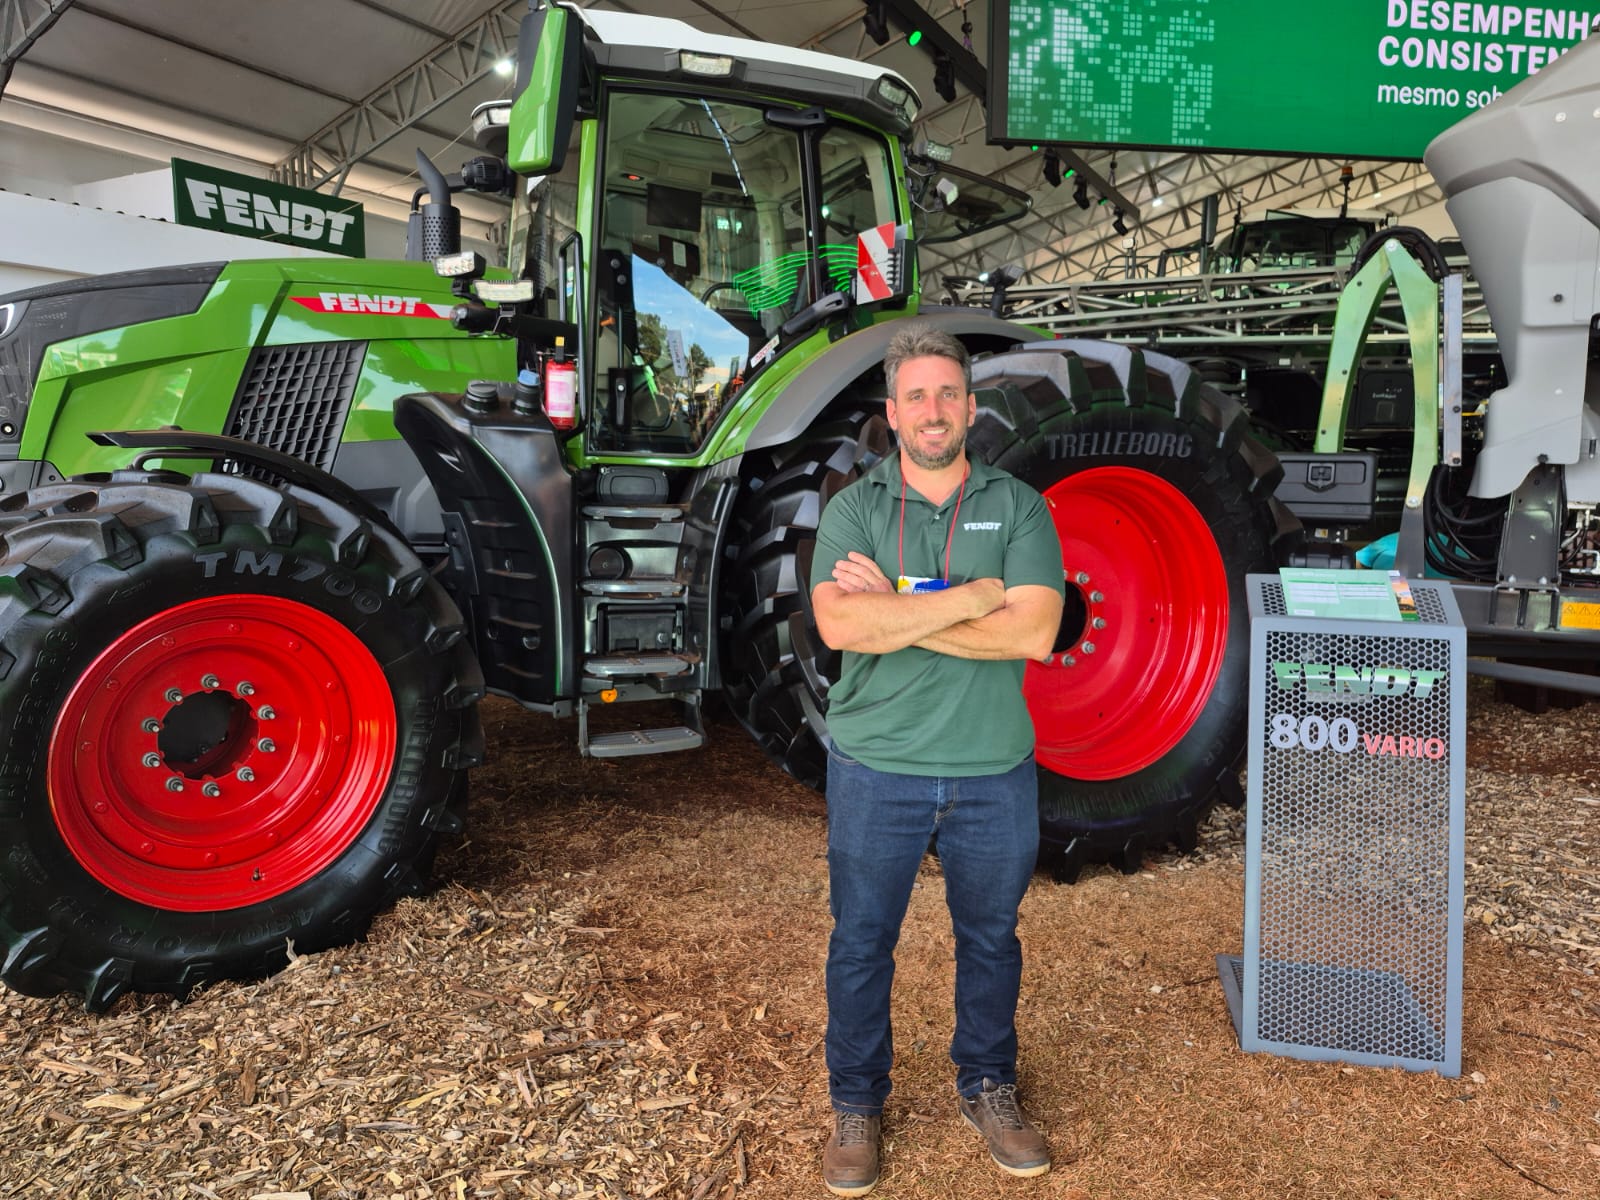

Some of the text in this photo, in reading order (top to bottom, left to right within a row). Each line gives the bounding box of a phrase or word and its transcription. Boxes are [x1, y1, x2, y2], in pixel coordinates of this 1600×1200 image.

[1377, 83, 1460, 107] mesmo
[185, 177, 355, 246] FENDT
[318, 292, 422, 315] FENDT
[1044, 431, 1193, 460] TRELLEBORG
[963, 521, 1002, 531] FENDT
[192, 549, 382, 614] TM700
[1272, 661, 1446, 698] FENDT
[1269, 713, 1445, 759] 800 VARIO
